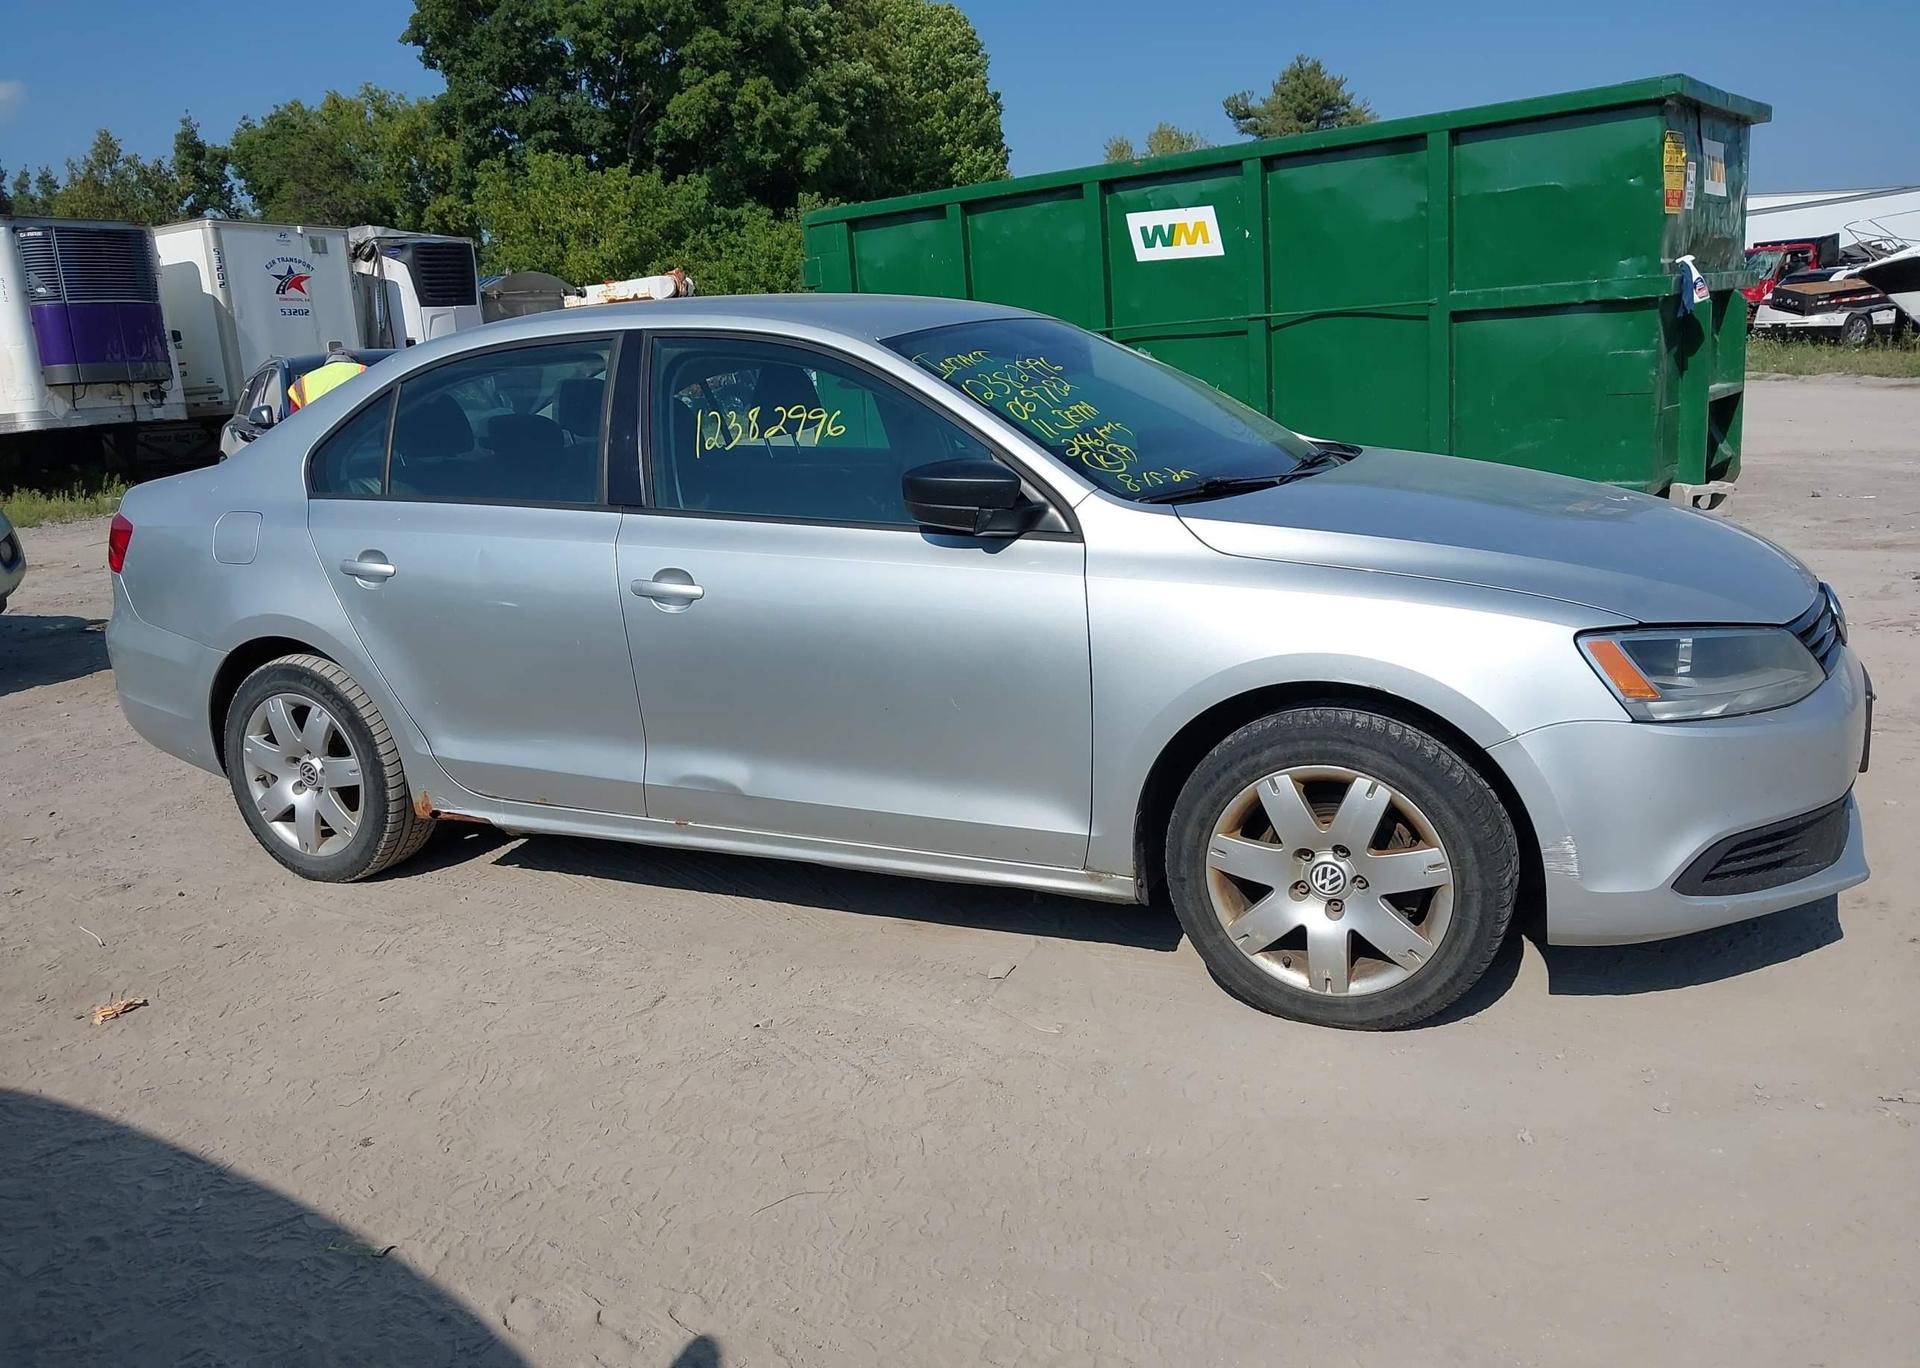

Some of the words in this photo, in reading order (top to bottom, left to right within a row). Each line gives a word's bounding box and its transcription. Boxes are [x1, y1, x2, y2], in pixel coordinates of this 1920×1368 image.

[1140, 220, 1210, 249] WM
[212, 247, 227, 289] 53202
[276, 256, 315, 272] TRANSPORT
[280, 308, 310, 317] 53202
[961, 356, 1064, 407] 12382996
[1006, 376, 1080, 420] 069782
[695, 404, 847, 460] 12382996
